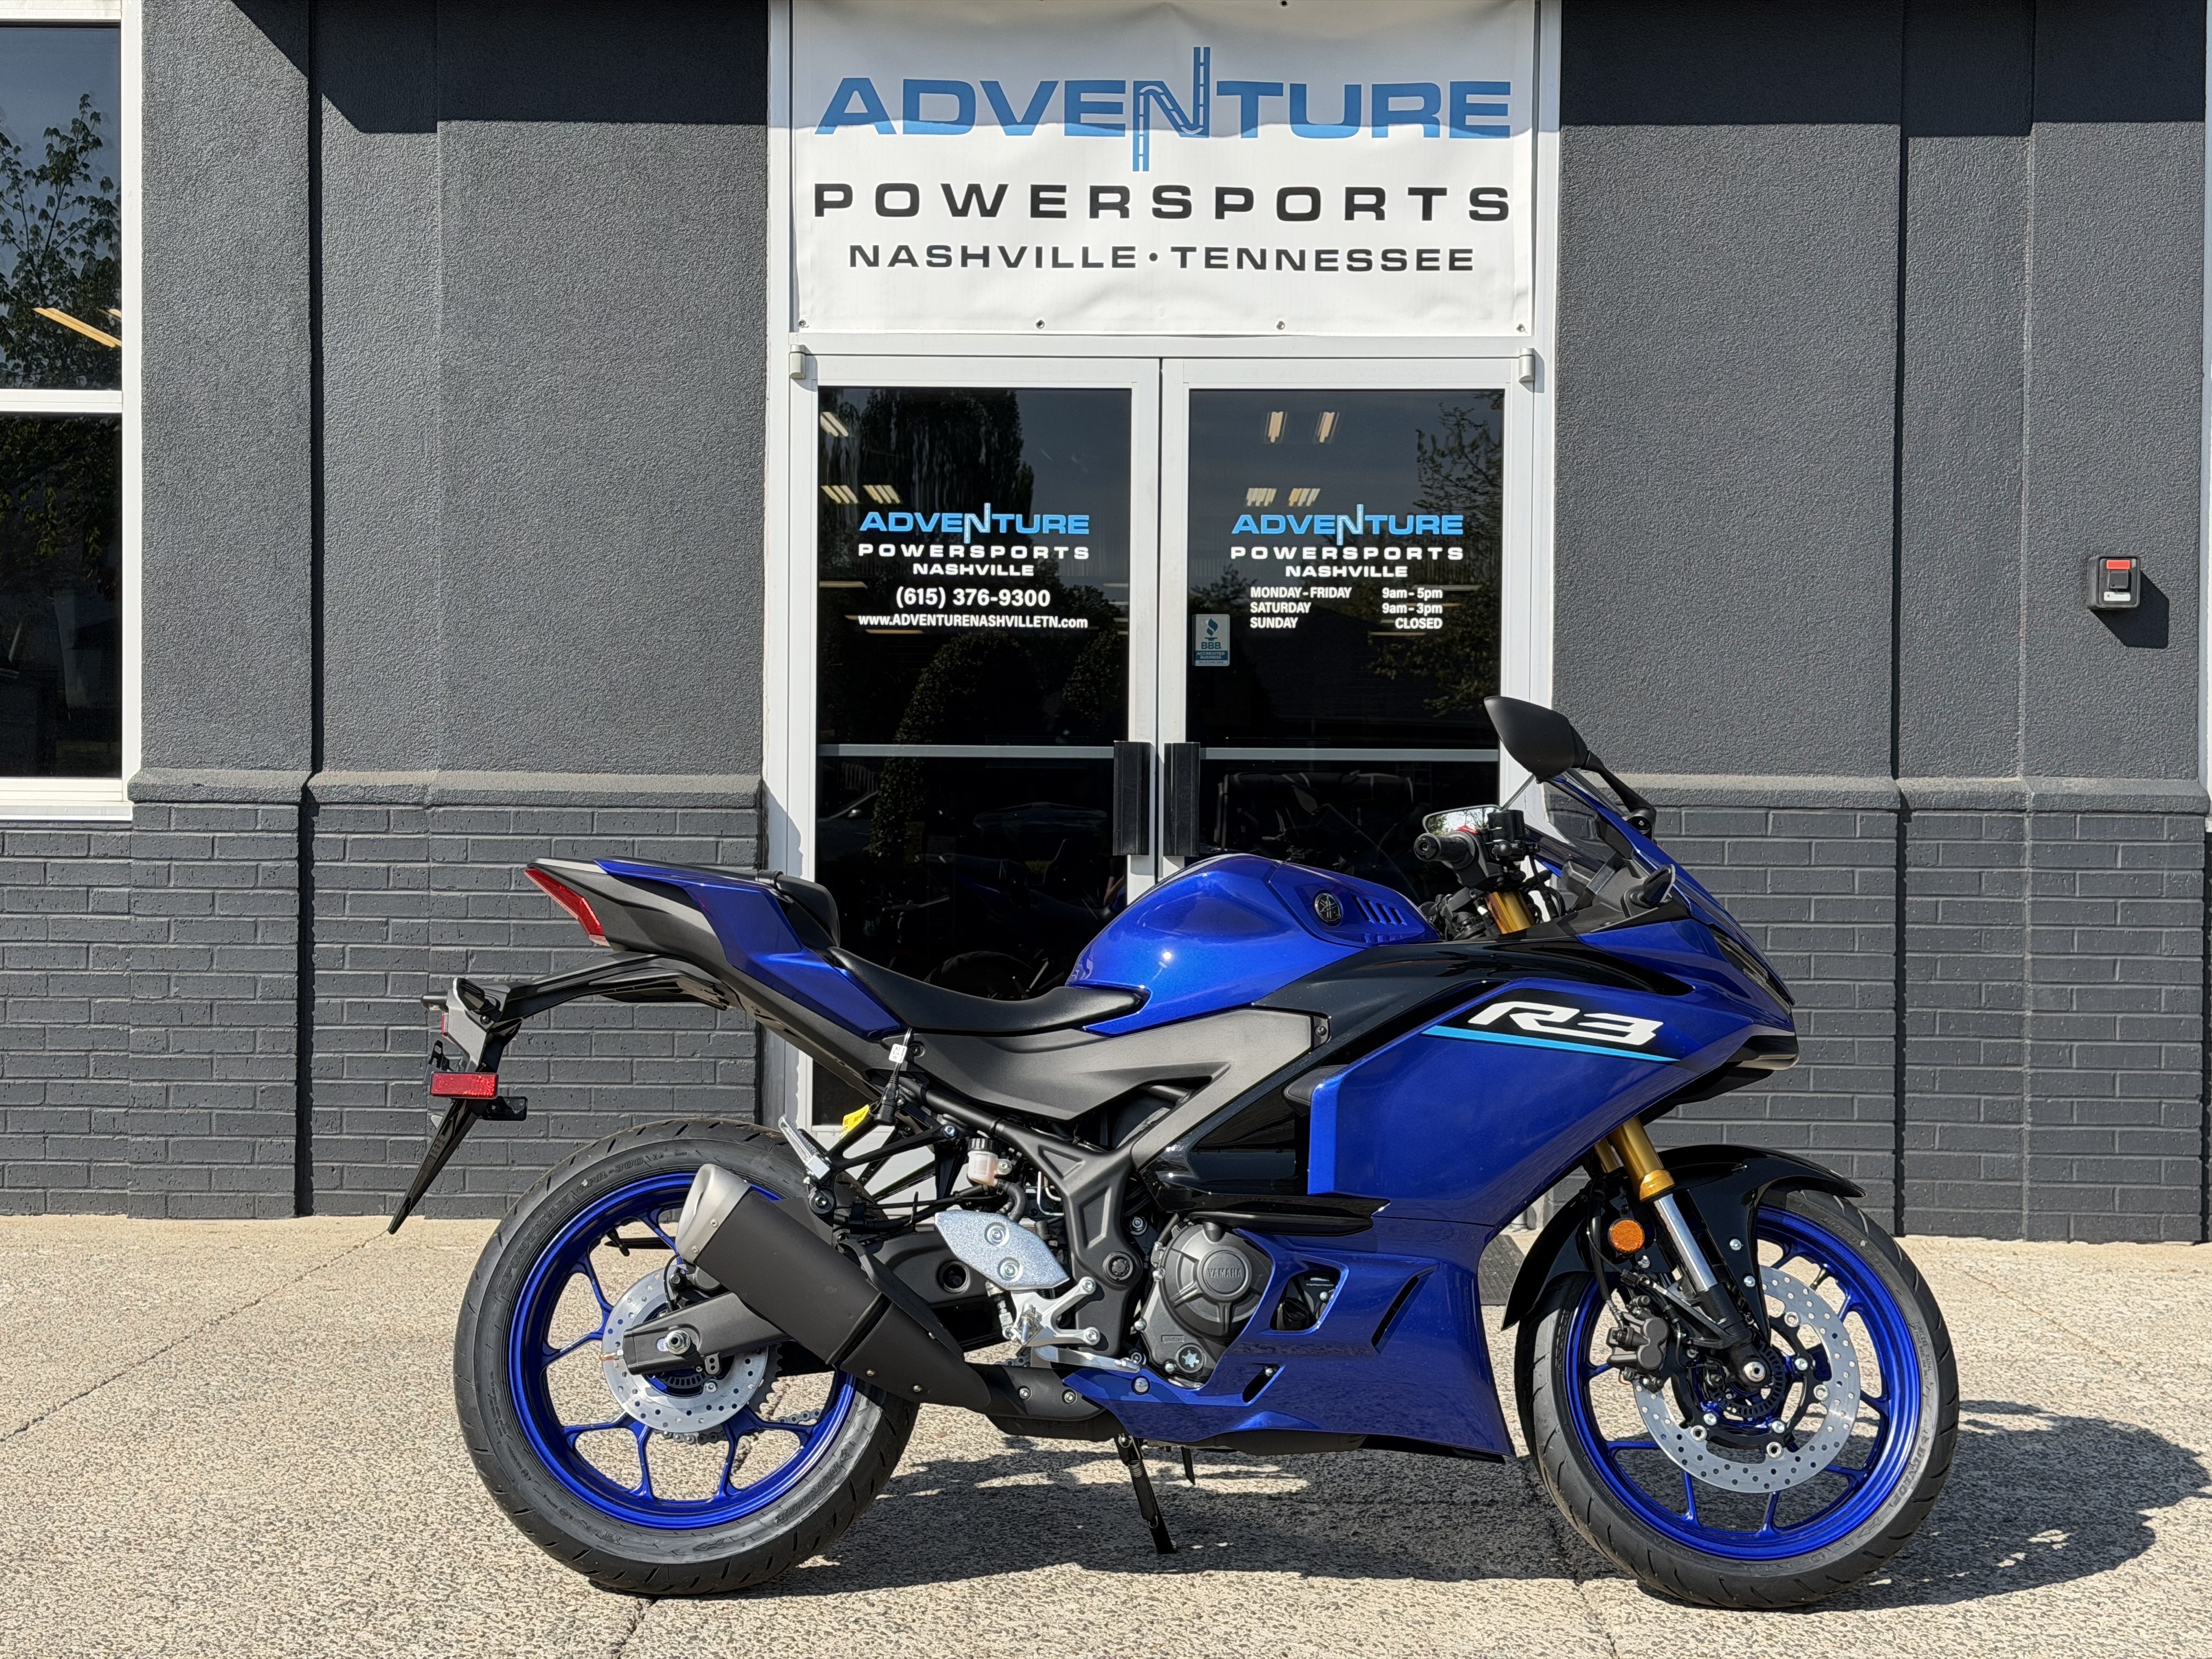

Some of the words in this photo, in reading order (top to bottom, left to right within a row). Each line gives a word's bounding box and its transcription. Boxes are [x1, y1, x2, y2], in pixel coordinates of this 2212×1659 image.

[815, 46, 1511, 172] ADVENTURE
[815, 183, 1509, 222] POWERSPORTS
[850, 245, 1136, 268] NASHVILLE
[1171, 246, 1473, 272] TENNESSEE
[860, 503, 1090, 544] ADVENTURE
[1232, 504, 1464, 545] ADVENTURE
[858, 543, 1089, 560] POWERSPORTS
[1231, 546, 1463, 560] POWERSPORTS
[913, 563, 1034, 577] NASHVILLE
[1285, 566, 1408, 578] NASHVILLE
[896, 586, 946, 609] (615)
[952, 588, 1051, 607] 376-9300
[1250, 601, 1312, 613] SATURDAY
[857, 613, 1088, 628] www.ADVENTURENASHVILLETN.com
[1250, 617, 1299, 629] SUNDAY
[1395, 617, 1443, 629] CLOSED
[1201, 641, 1221, 650] BBB
[1468, 1001, 1663, 1045] R3
[497, 1193, 571, 1294] SPORTMAX
[1207, 1268, 1243, 1278] YAMAHA
